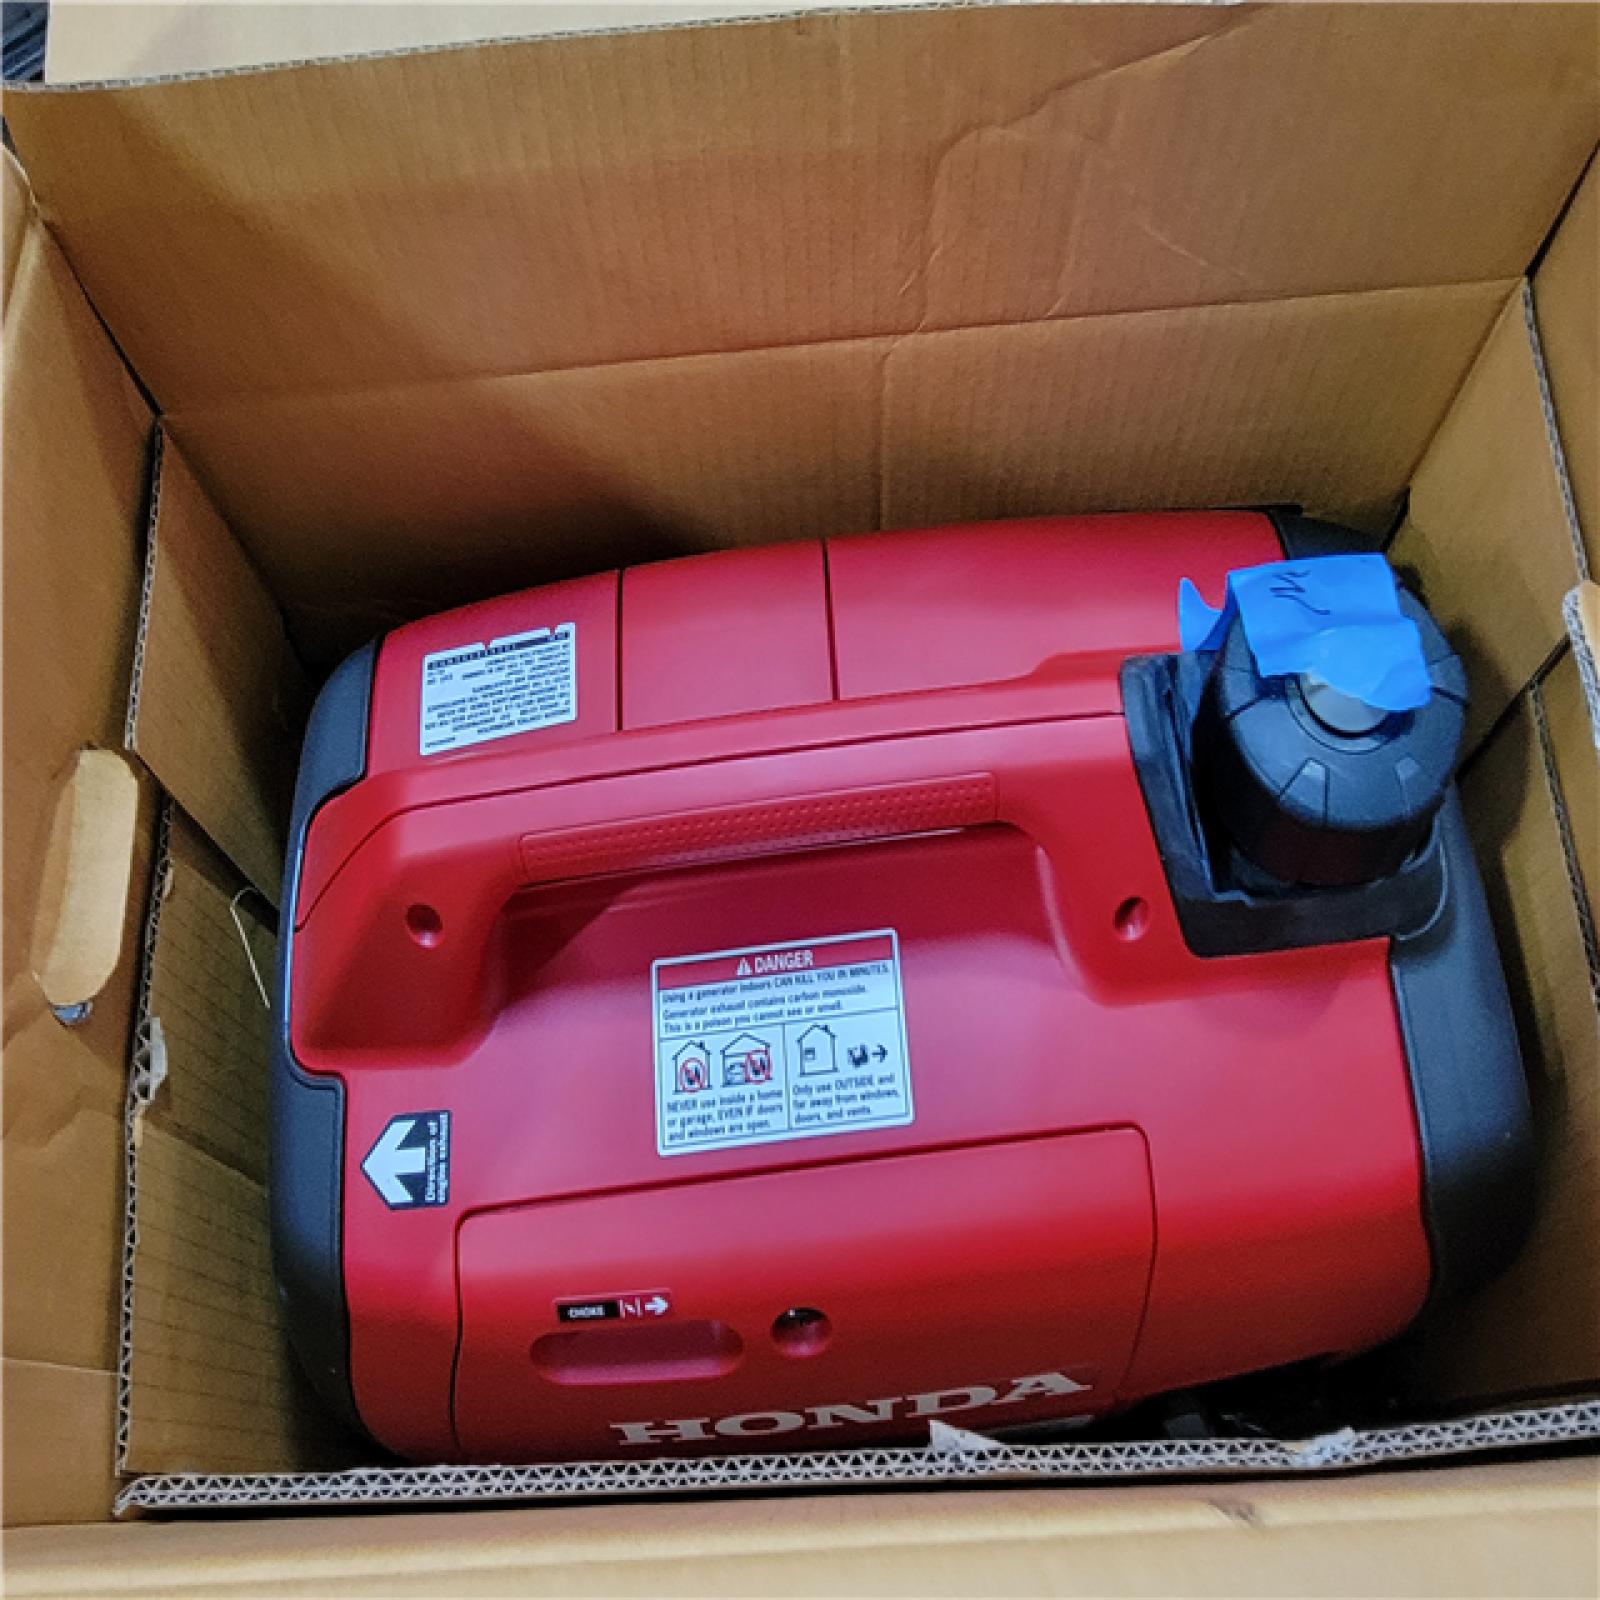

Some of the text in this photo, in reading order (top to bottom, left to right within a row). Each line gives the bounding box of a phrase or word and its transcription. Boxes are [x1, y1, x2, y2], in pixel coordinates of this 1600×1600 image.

[754, 949, 813, 973] DANGER
[662, 990, 685, 1004] Using
[697, 984, 737, 1001] generator
[740, 979, 771, 993] indoors
[774, 976, 793, 988] CAN
[795, 973, 815, 986] KILL
[816, 971, 836, 982] YOU
[664, 1004, 707, 1020] Generator
[710, 1001, 745, 1013] exhaust
[748, 996, 785, 1009] contains
[788, 991, 820, 1003] carbon
[664, 1021, 681, 1033] This
[703, 1016, 732, 1030] poison
[735, 1014, 751, 1026] you
[754, 1008, 783, 1021] cannot
[787, 1007, 802, 1016] see
[793, 1072, 895, 1096] Only use OUTSIDE and
[667, 1099, 697, 1112] NEVER
[700, 1099, 715, 1109] use
[719, 1093, 746, 1106] inside
[758, 1089, 783, 1100] home
[718, 1107, 743, 1121] EVEN
[757, 1103, 783, 1115] doors
[809, 1096, 832, 1108] away
[834, 1093, 858, 1105] from
[827, 1108, 843, 1119] and
[669, 1131, 685, 1142] and
[688, 1126, 725, 1138] windows
[728, 1124, 743, 1133] are
[425, 1119, 438, 1202] Direction of
[609, 1372, 1092, 1446] HONDA
